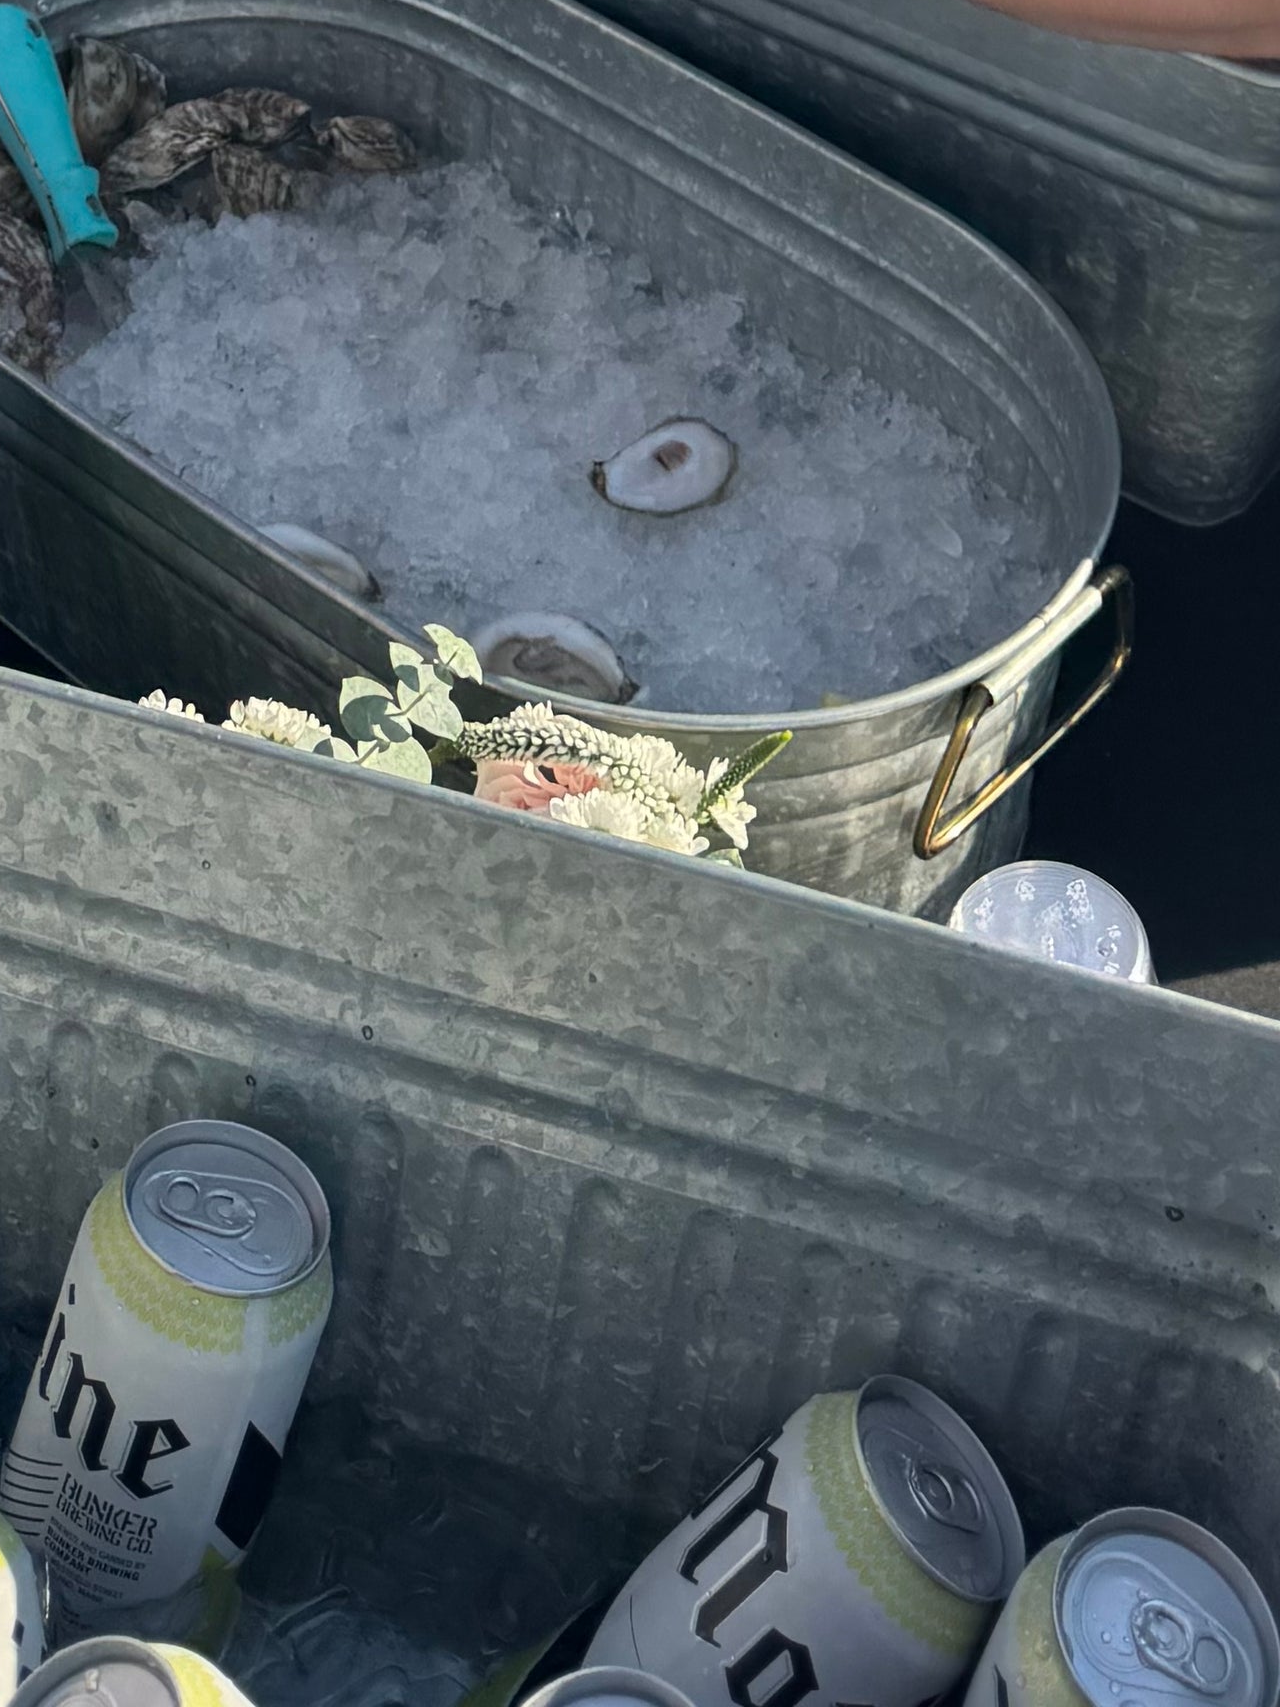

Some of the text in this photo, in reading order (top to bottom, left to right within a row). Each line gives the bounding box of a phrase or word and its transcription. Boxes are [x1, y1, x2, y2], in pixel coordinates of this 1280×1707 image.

[56, 1493, 153, 1555] BREWING CO.
[61, 1472, 158, 1539] BUNKER
[44, 1536, 92, 1574] COMPANY
[47, 1526, 85, 1561] BUNKER
[88, 1556, 140, 1581] BREWING
